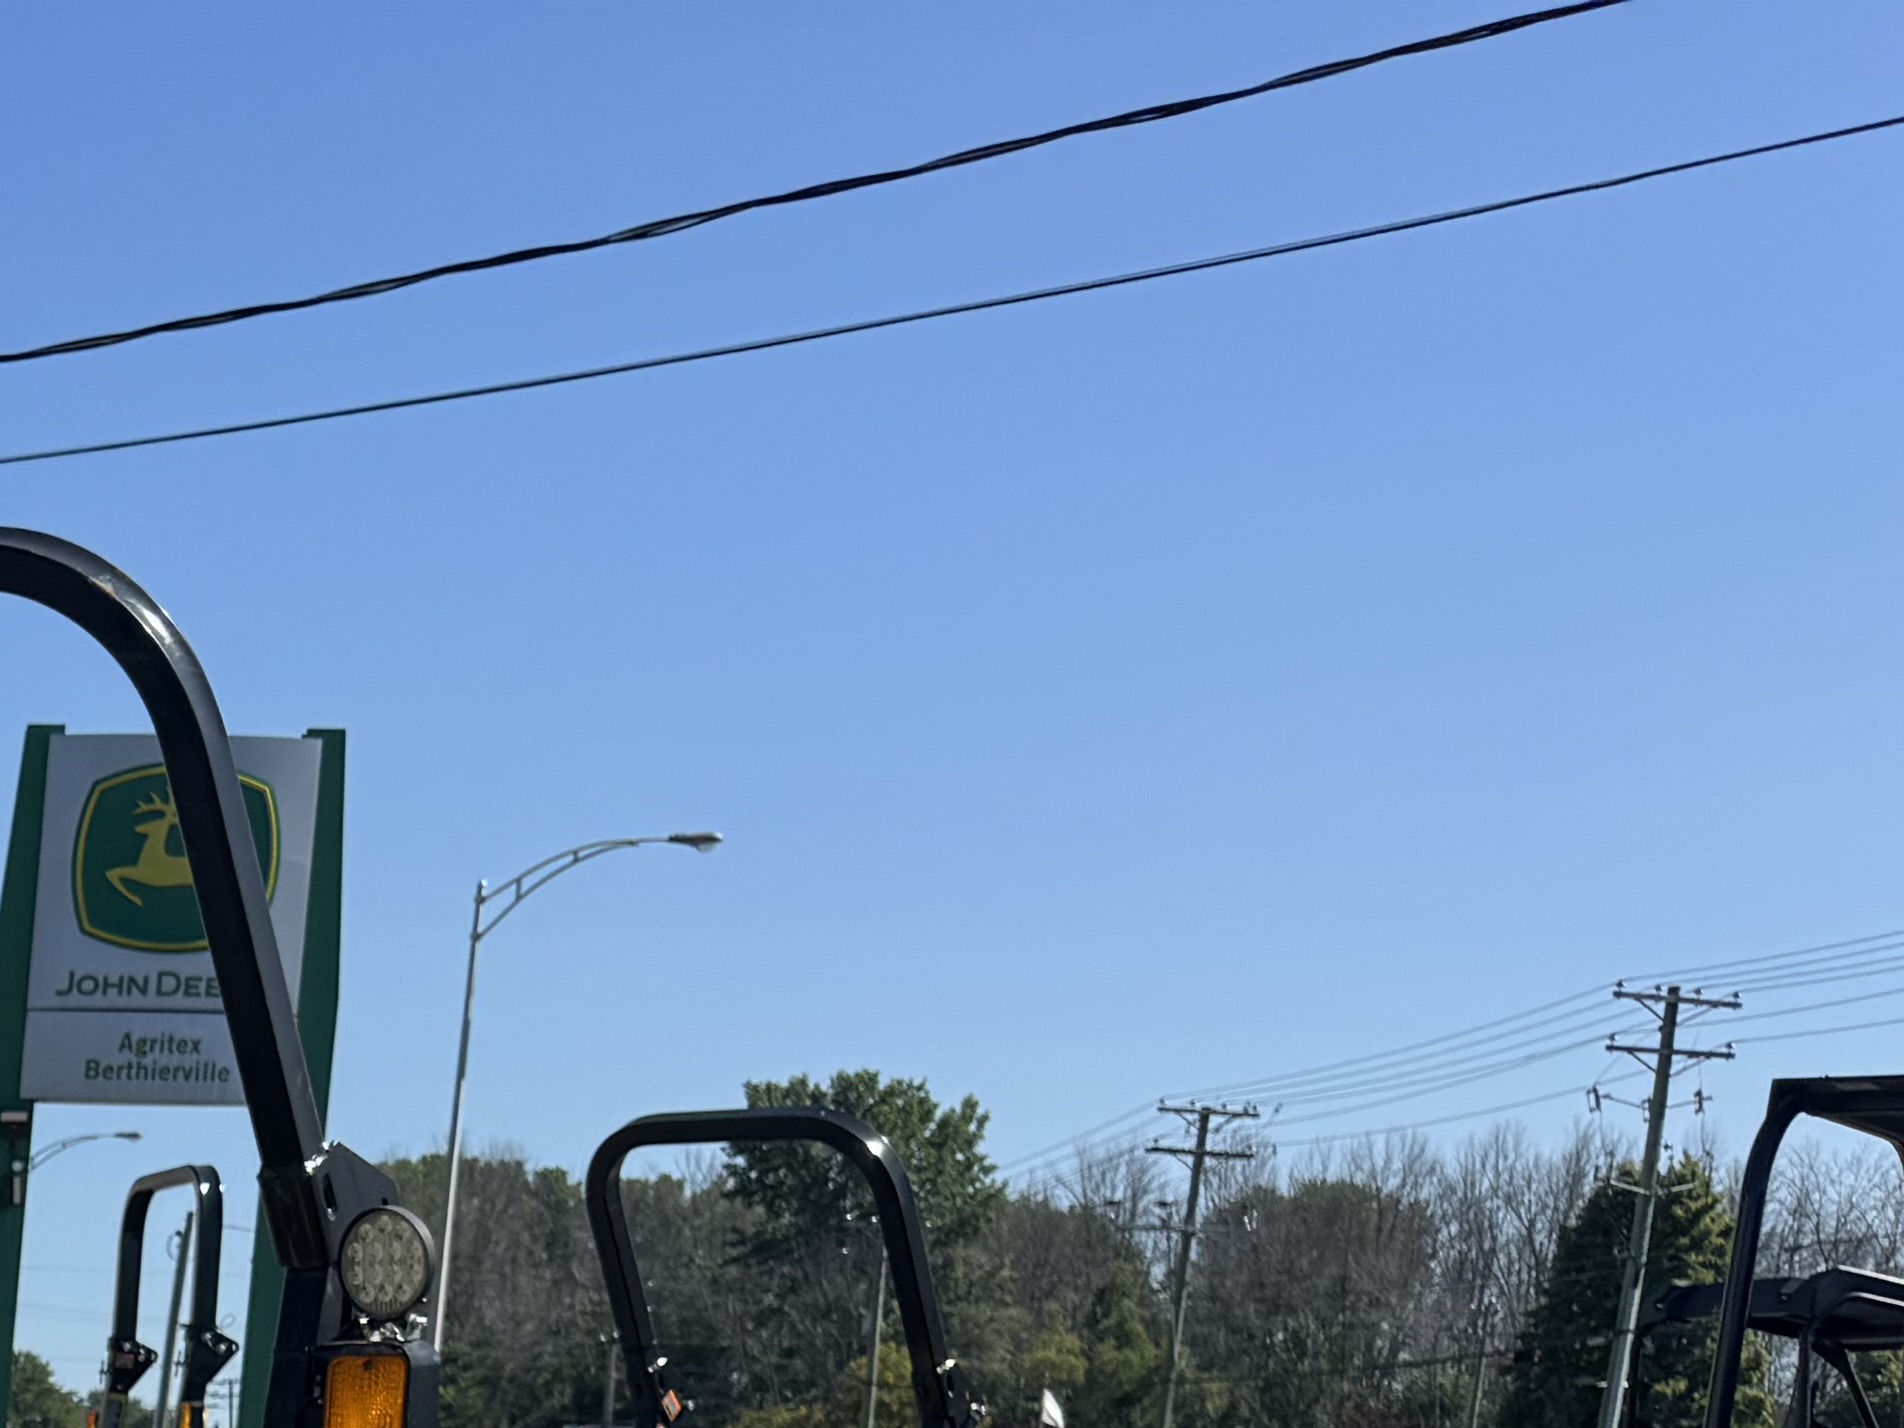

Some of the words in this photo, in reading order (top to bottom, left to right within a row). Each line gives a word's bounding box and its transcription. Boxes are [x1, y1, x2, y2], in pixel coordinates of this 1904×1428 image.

[55, 970, 149, 997] JOHN
[155, 971, 220, 998] DEE
[118, 1031, 202, 1058] Agritex
[84, 1060, 230, 1083] Berthierville
